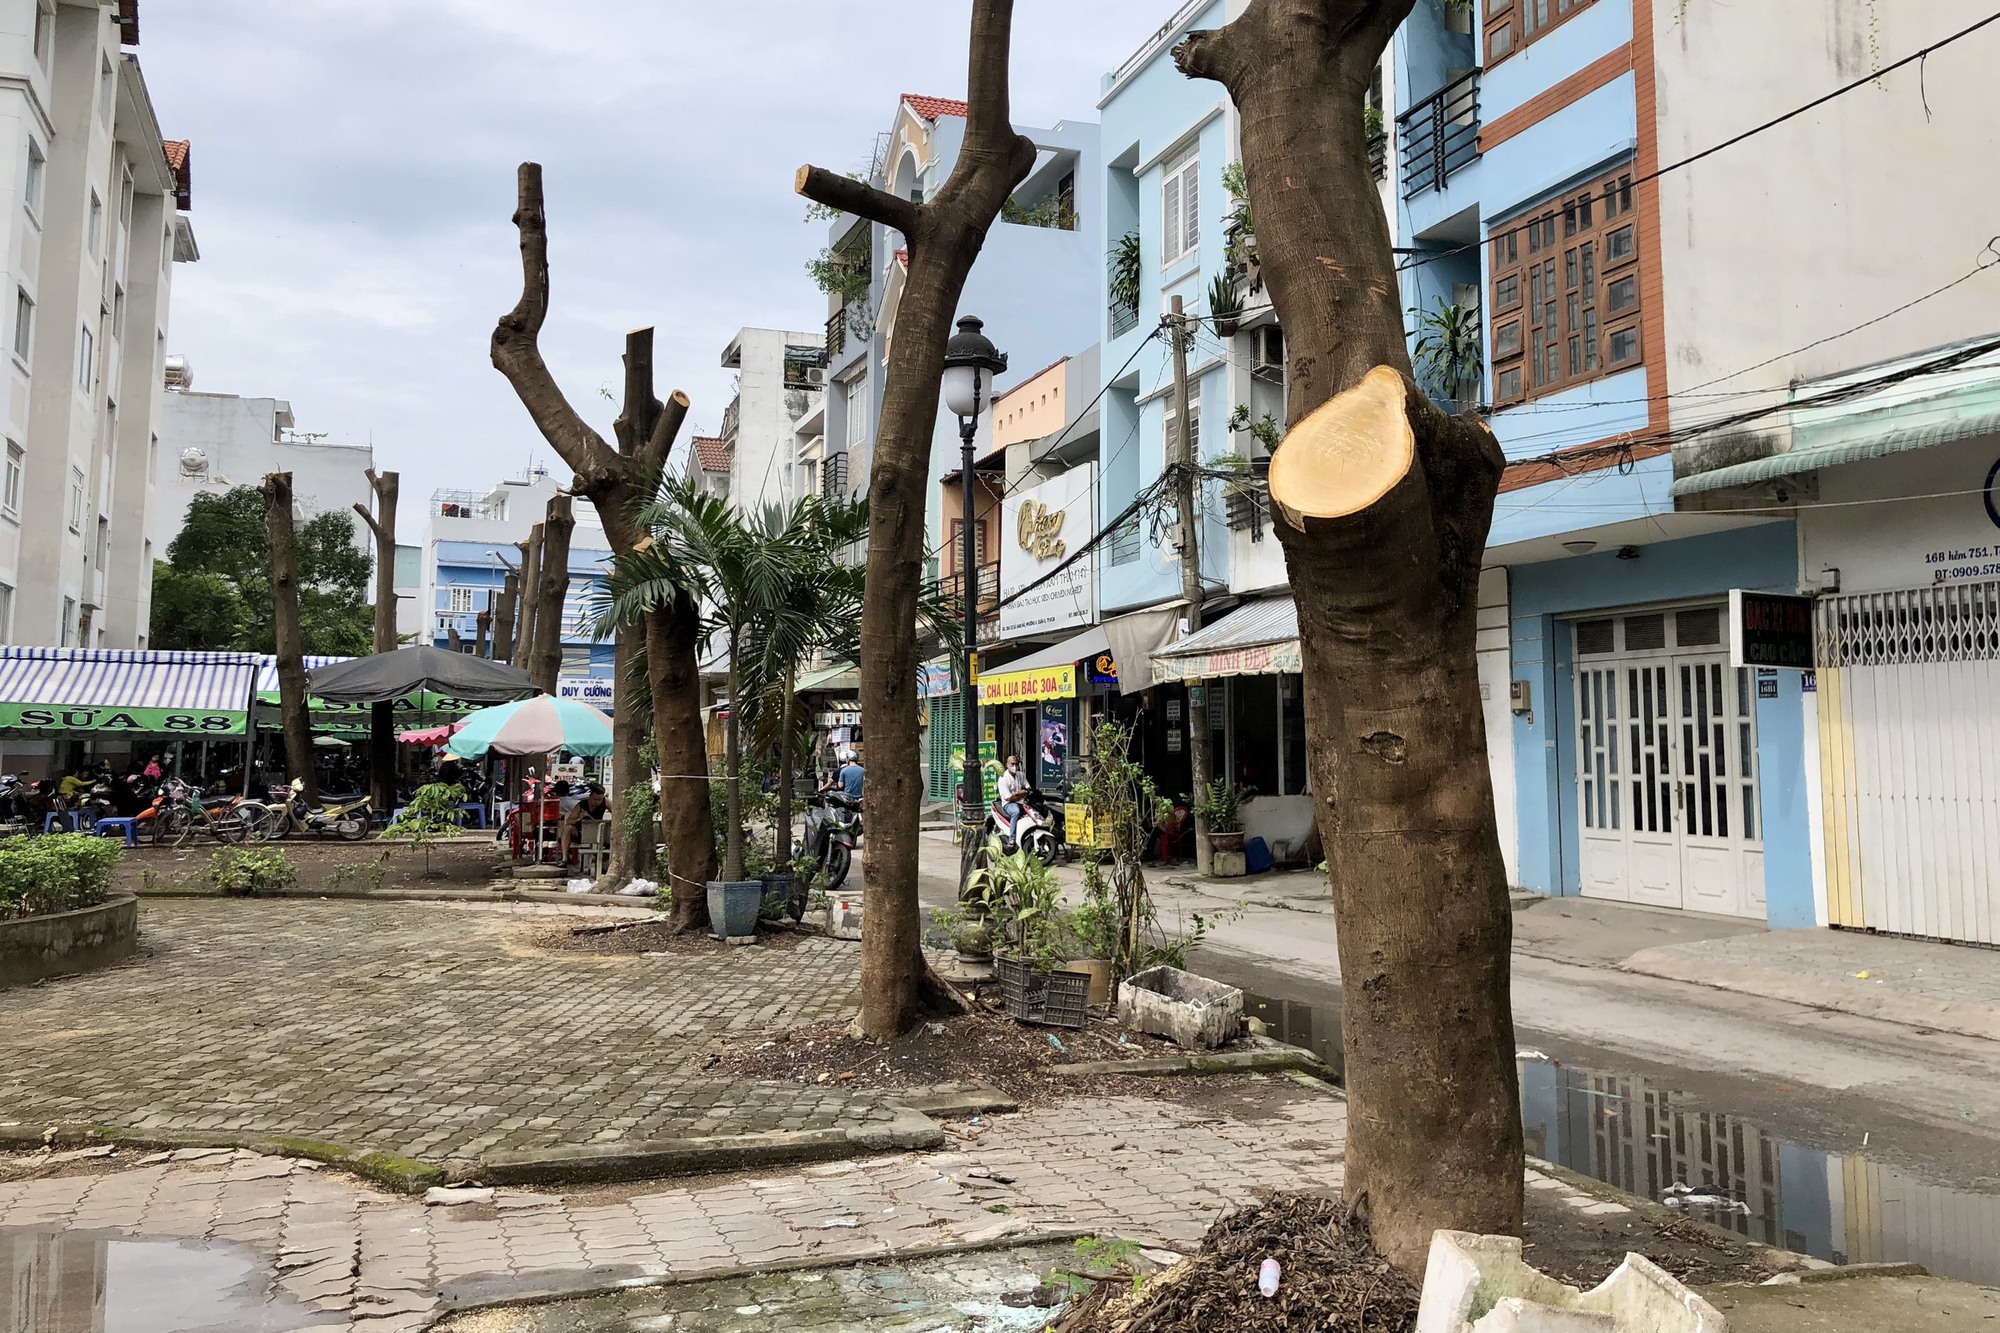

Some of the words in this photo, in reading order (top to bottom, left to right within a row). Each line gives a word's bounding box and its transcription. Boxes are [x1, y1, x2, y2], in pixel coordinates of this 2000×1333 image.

[1925, 551, 1945, 563] 16B
[562, 687, 580, 697] DUY
[986, 678, 1001, 698] CHẢ
[1004, 681, 1019, 699] LỤA
[1022, 673, 1038, 695] BẮC
[1040, 678, 1057, 692] 30A
[20, 707, 144, 729] SỮA
[163, 714, 232, 730] 88
